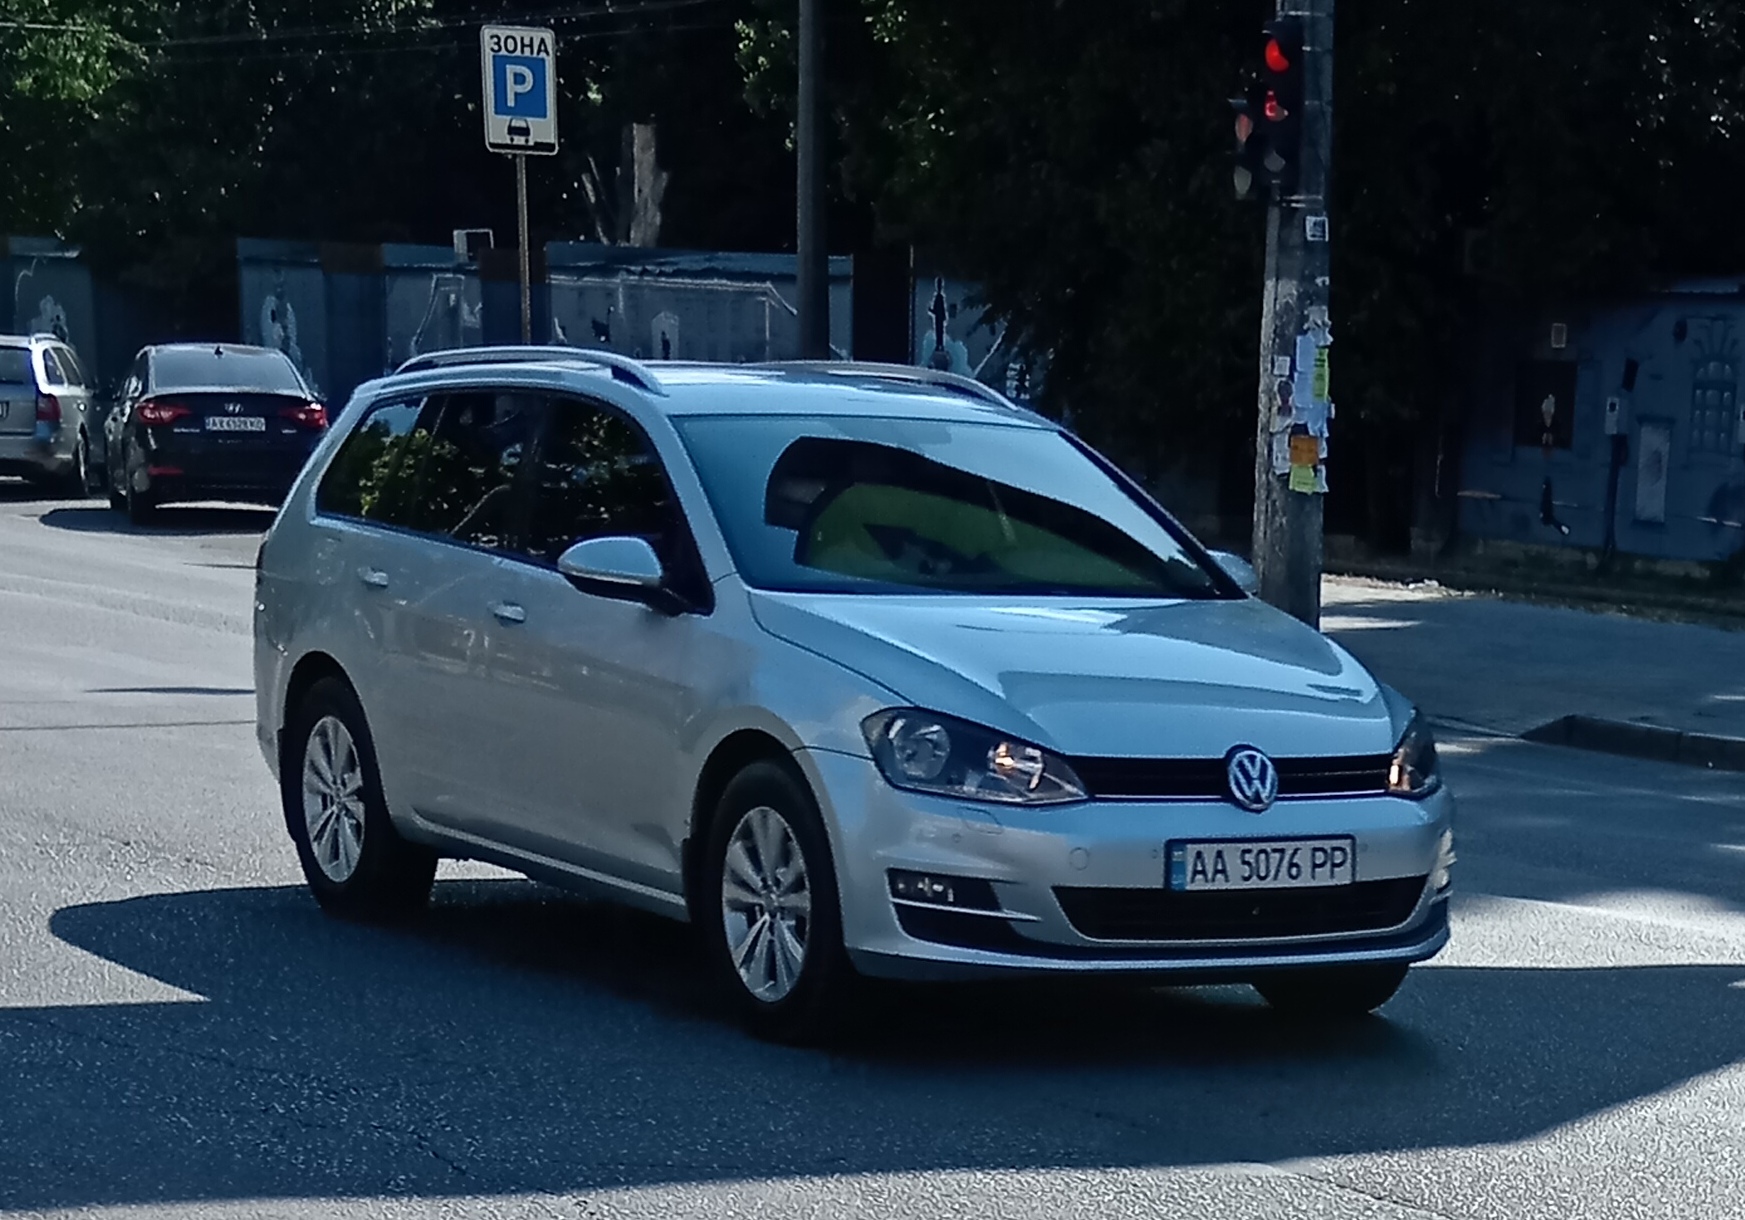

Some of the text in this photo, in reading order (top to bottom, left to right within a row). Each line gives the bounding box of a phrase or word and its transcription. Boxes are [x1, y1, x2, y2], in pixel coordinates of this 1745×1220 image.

[489, 34, 550, 57] ЗОНА
[505, 64, 534, 108] P
[1190, 846, 1348, 883] AA 5076 PP
